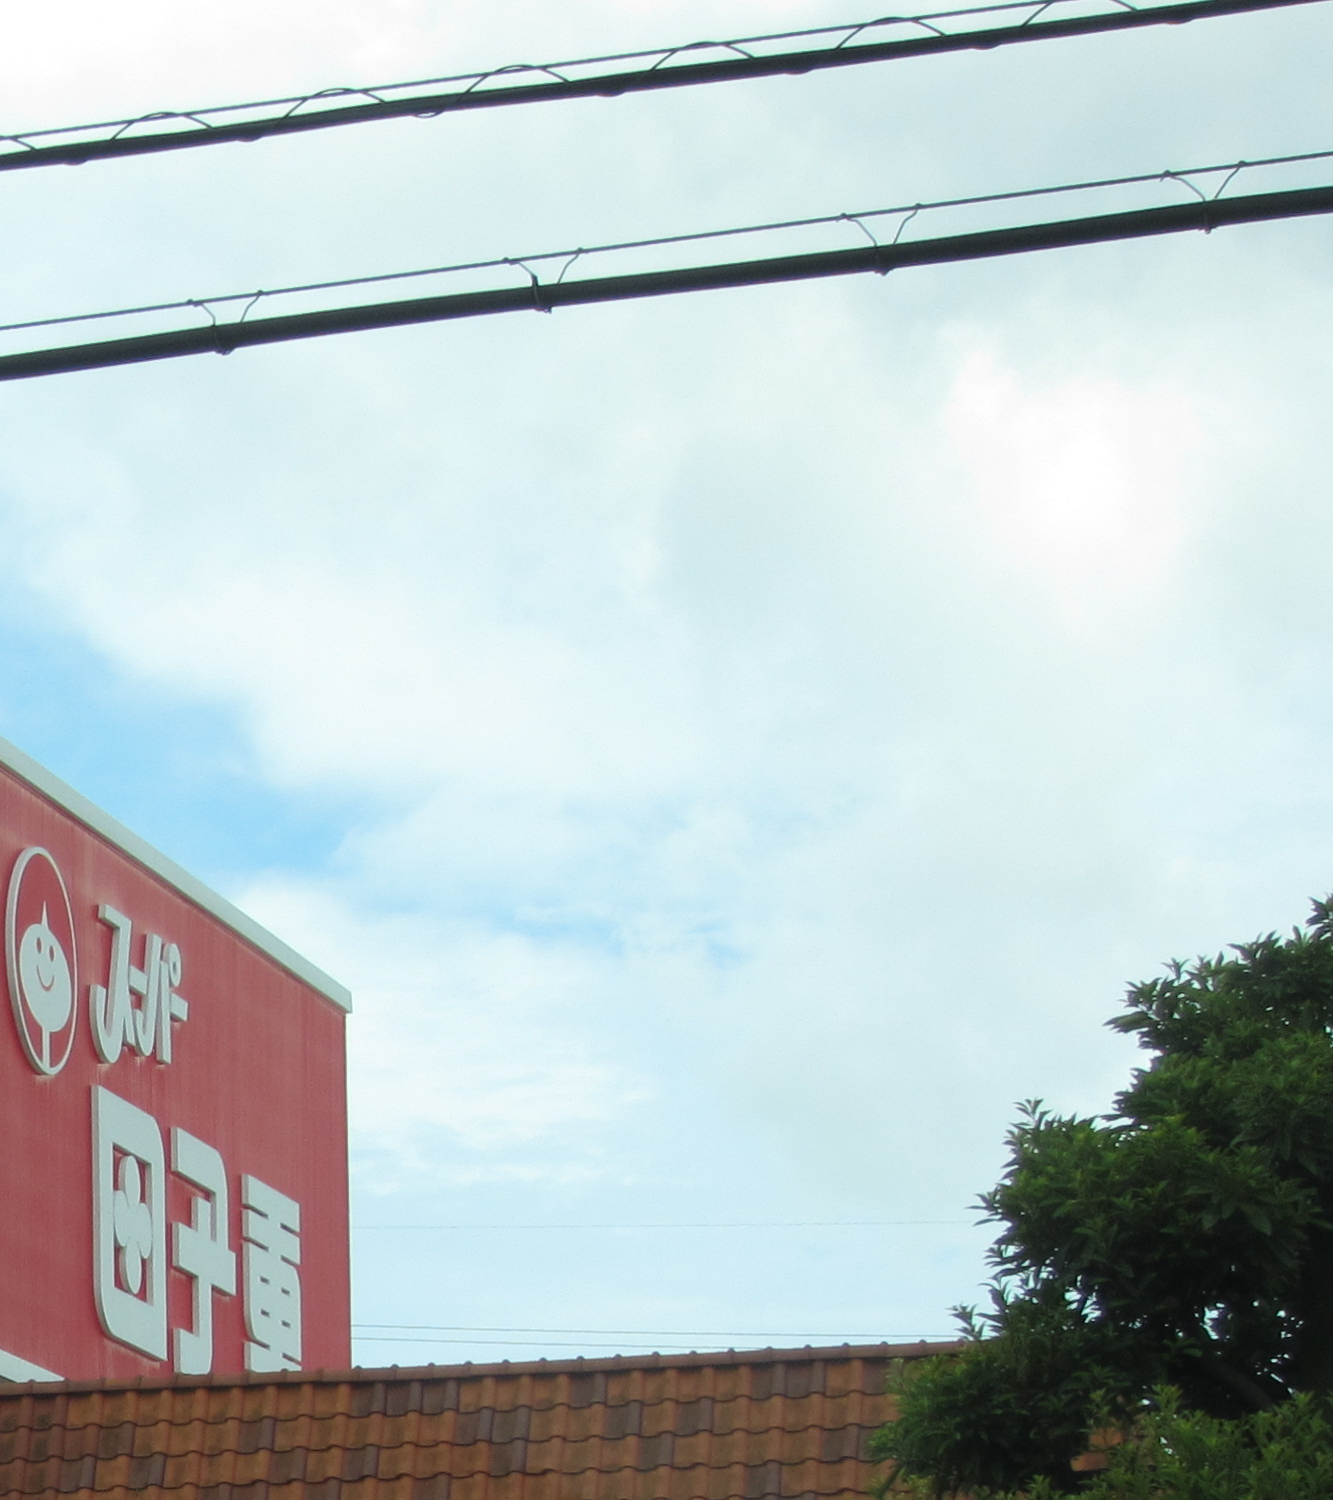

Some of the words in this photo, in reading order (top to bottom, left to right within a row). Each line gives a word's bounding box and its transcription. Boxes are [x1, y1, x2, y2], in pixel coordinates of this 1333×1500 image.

[89, 903, 188, 1065] スーパー
[91, 1085, 303, 1374] 田子重
